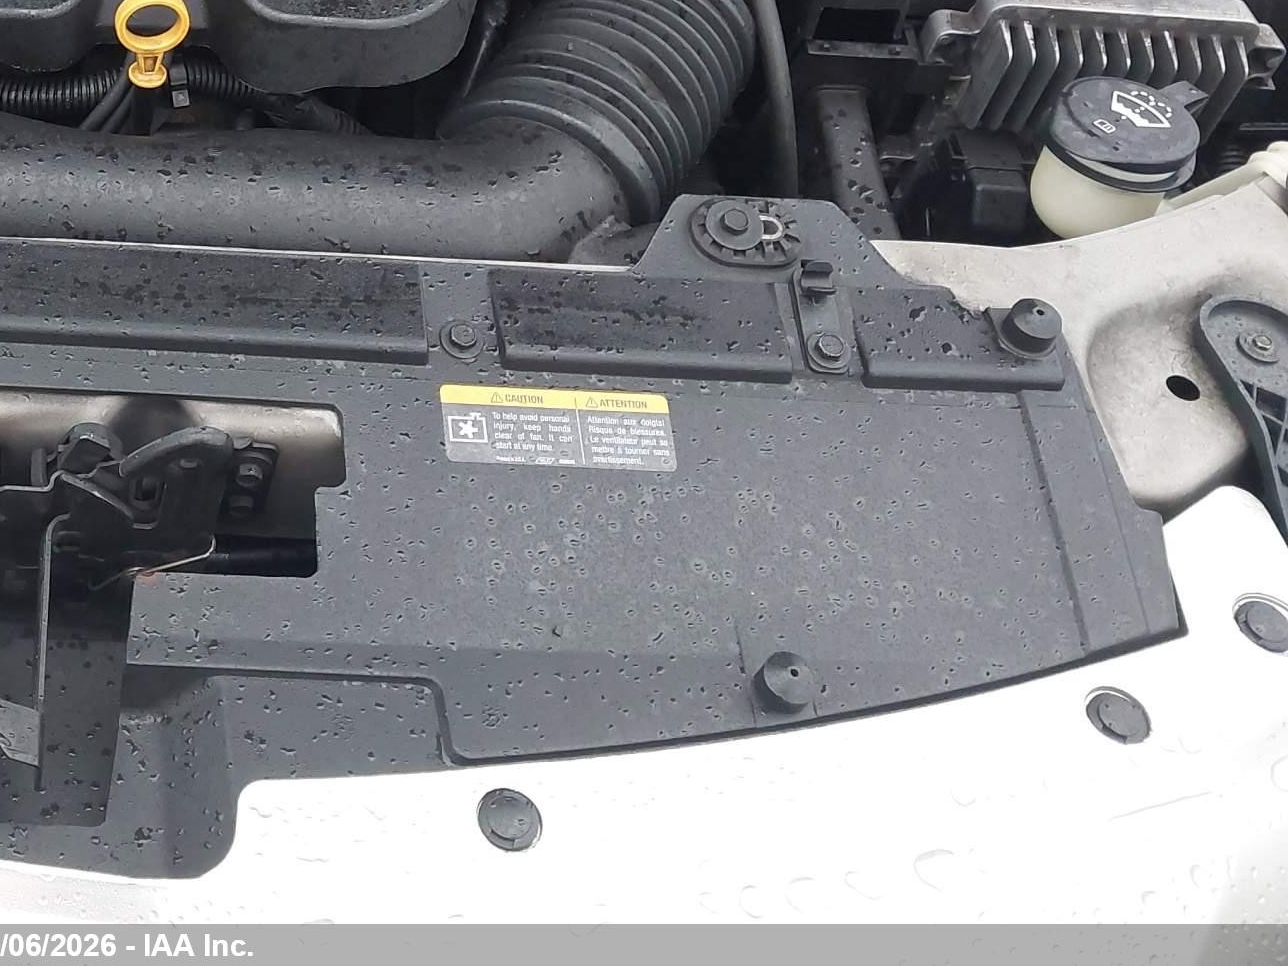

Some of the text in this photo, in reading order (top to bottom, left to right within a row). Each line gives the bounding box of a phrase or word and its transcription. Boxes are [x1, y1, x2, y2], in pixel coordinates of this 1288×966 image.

[505, 393, 543, 404] CAUTION
[600, 399, 647, 409] ATTENTION
[492, 411, 501, 419] To
[502, 412, 517, 421] help
[519, 413, 538, 421] avoid
[587, 416, 619, 424] Attention
[523, 423, 542, 432] keep
[549, 424, 572, 433] hands
[588, 425, 613, 434] Risque
[494, 432, 512, 440] clear
[530, 433, 545, 441] fan.
[590, 435, 599, 443] Le
[602, 437, 638, 445] ventilateur
[641, 439, 657, 447] peut
[522, 443, 535, 451] any
[592, 446, 614, 454] mettre
[624, 447, 650, 455] tourner
